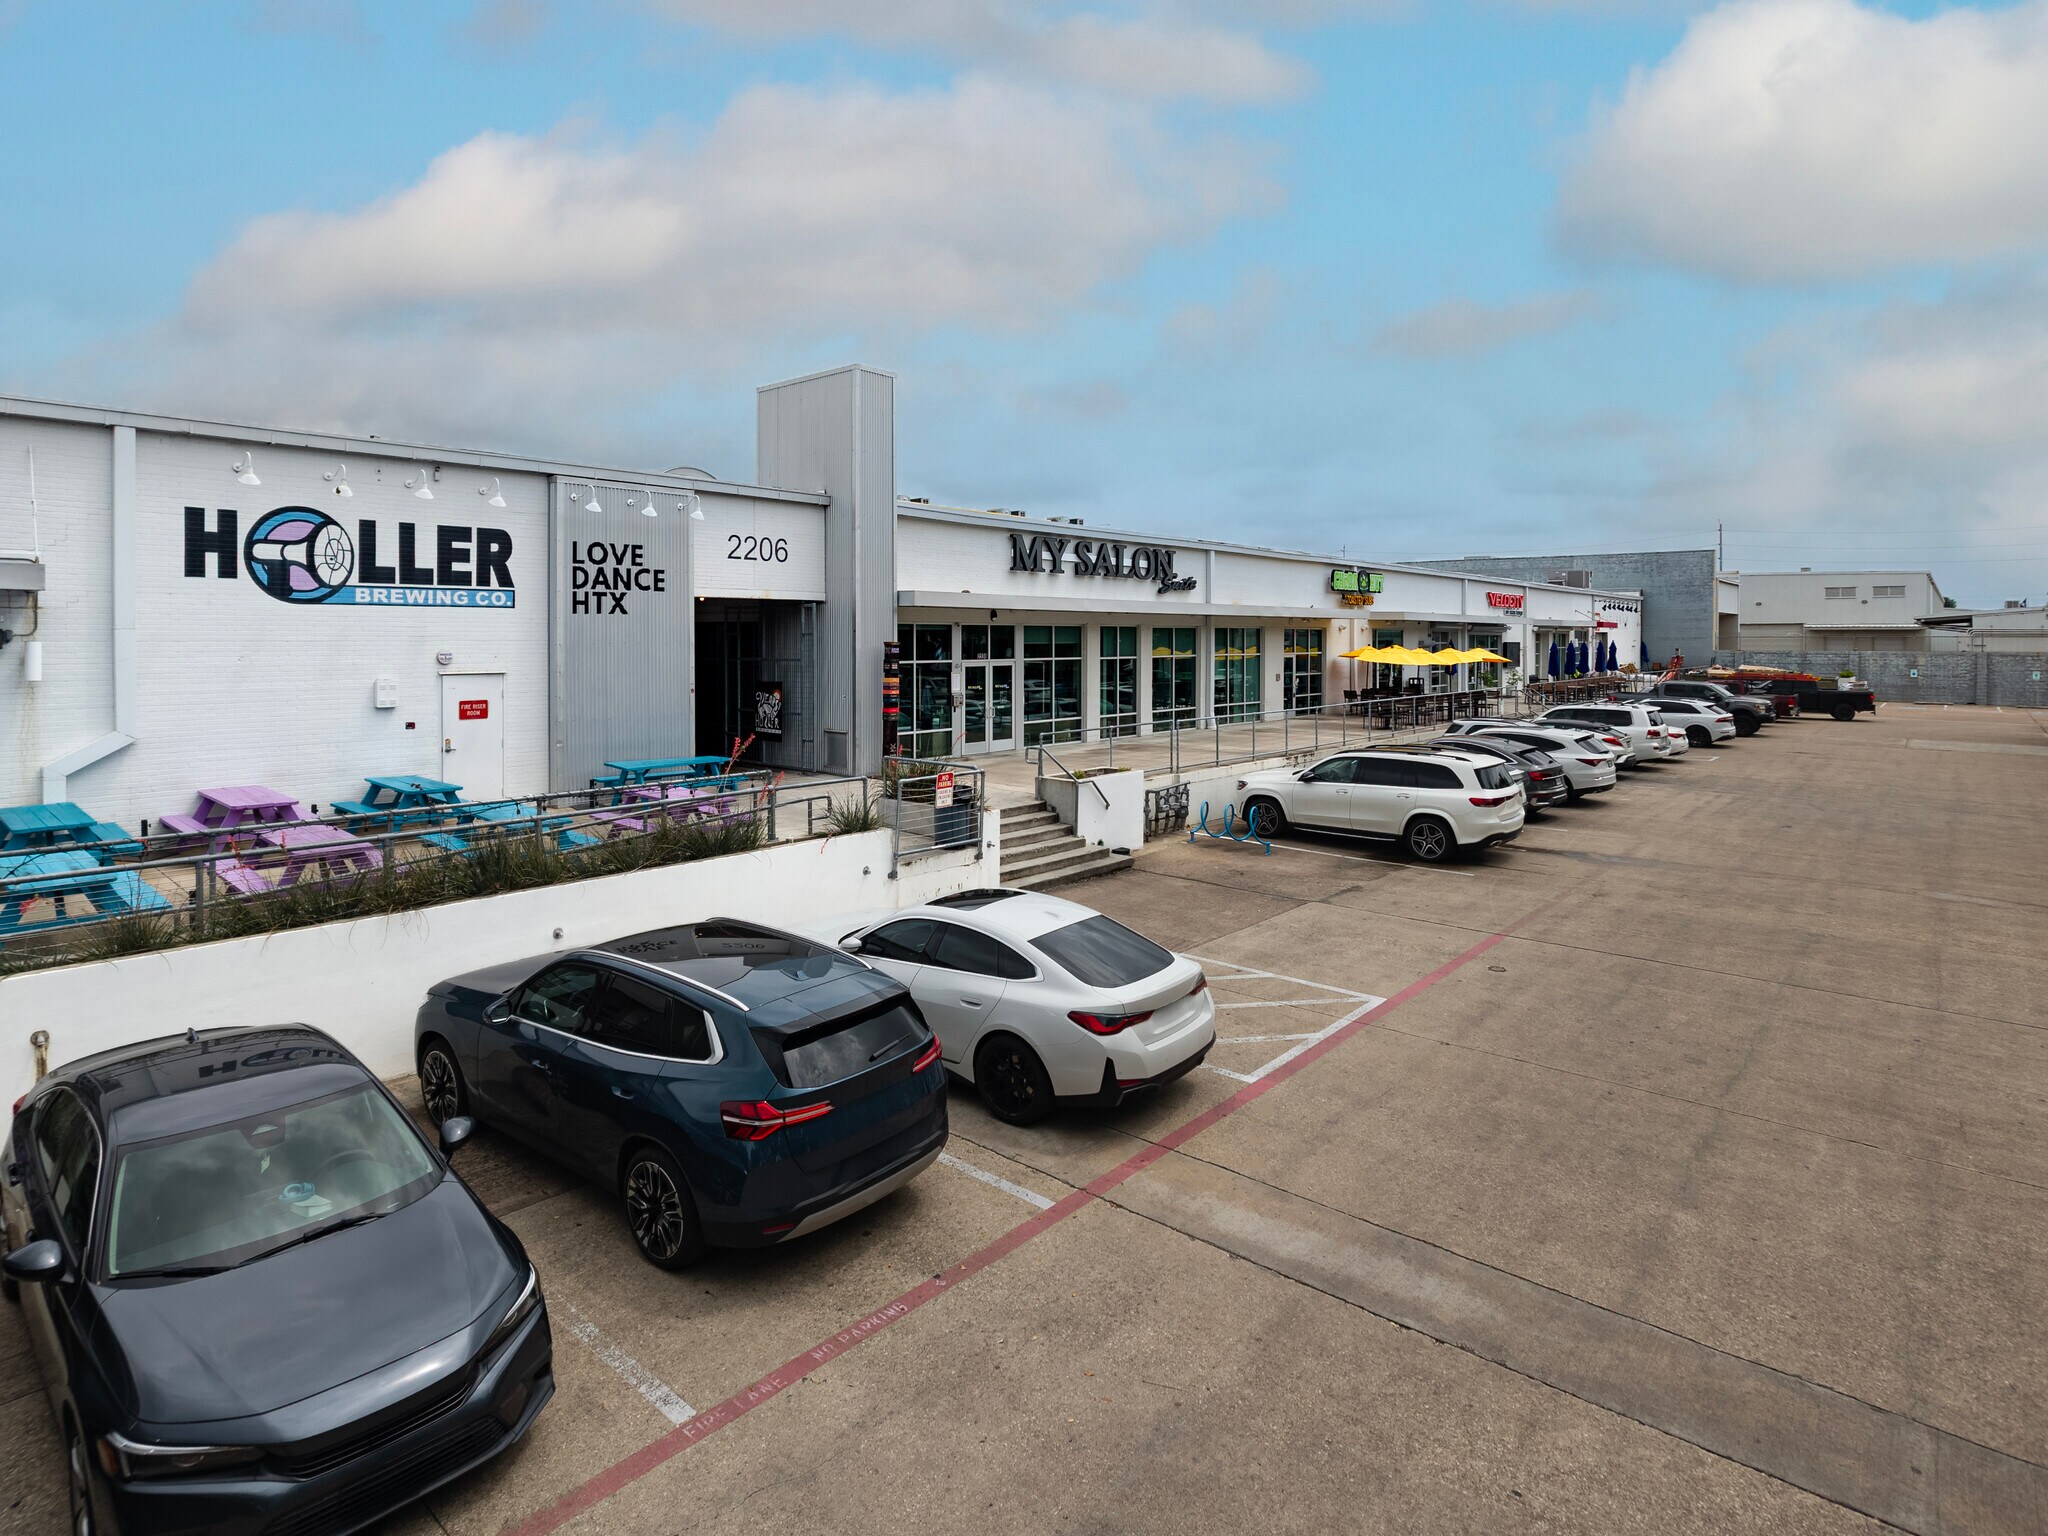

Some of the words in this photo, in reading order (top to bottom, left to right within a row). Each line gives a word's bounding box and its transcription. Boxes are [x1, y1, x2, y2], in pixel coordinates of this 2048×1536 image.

[184, 506, 515, 603] HOLLER
[572, 541, 643, 566] LOVE
[727, 534, 788, 563] 2206
[1010, 534, 1071, 573] MY
[1074, 540, 1176, 581] SALON
[572, 566, 665, 592] DANCE
[1158, 574, 1197, 594] Suite
[355, 587, 468, 605] BREWING
[475, 591, 512, 606] CO.
[572, 591, 628, 614] HTX
[1488, 592, 1524, 608] VELOCITY
[837, 1302, 908, 1344] PARKING
